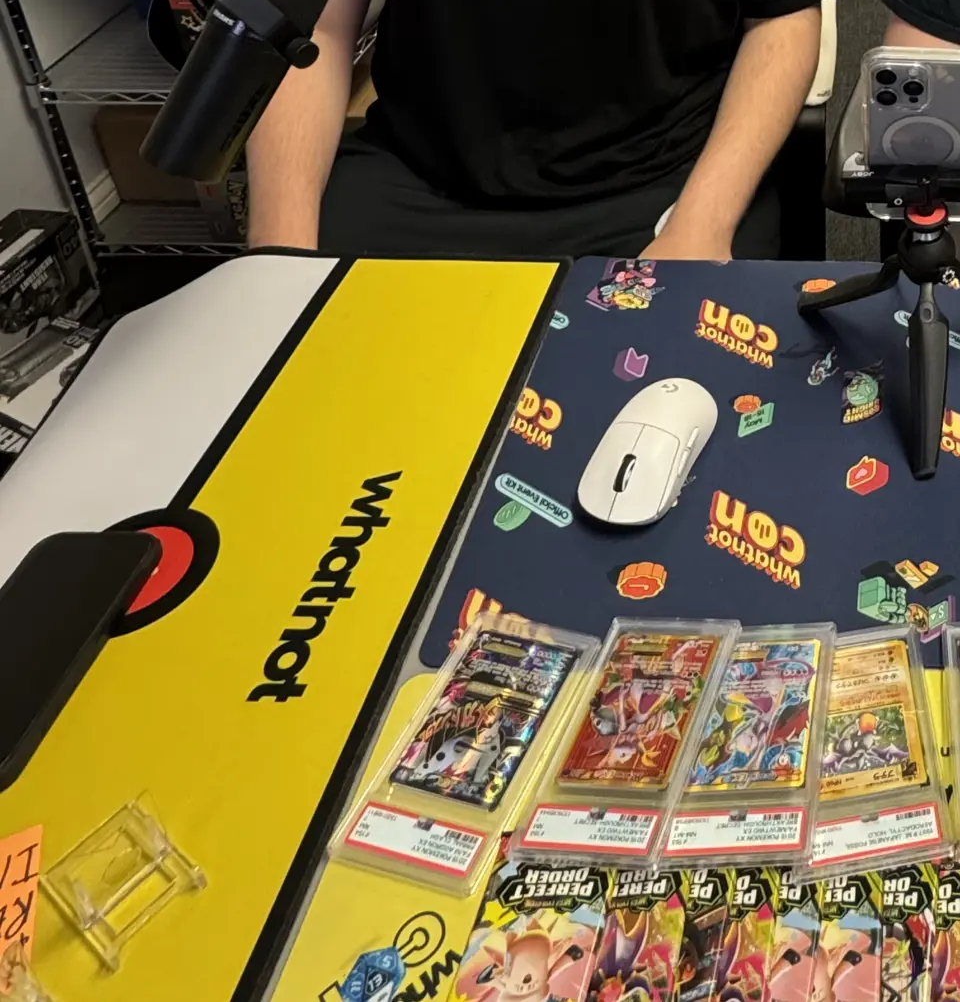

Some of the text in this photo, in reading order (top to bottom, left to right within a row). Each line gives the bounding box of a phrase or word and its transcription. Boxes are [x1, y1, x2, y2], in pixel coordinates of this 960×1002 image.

[695, 323, 775, 370] whatnot
[516, 484, 541, 504] Event
[540, 498, 570, 521] Official
[704, 522, 801, 590] whatnot
[245, 470, 404, 703] whatnot
[598, 833, 631, 843] POKEMON
[746, 833, 780, 842] POKEMON
[524, 867, 590, 885] ORDER
[509, 880, 594, 901] PERFECT
[612, 879, 667, 898] PERF
